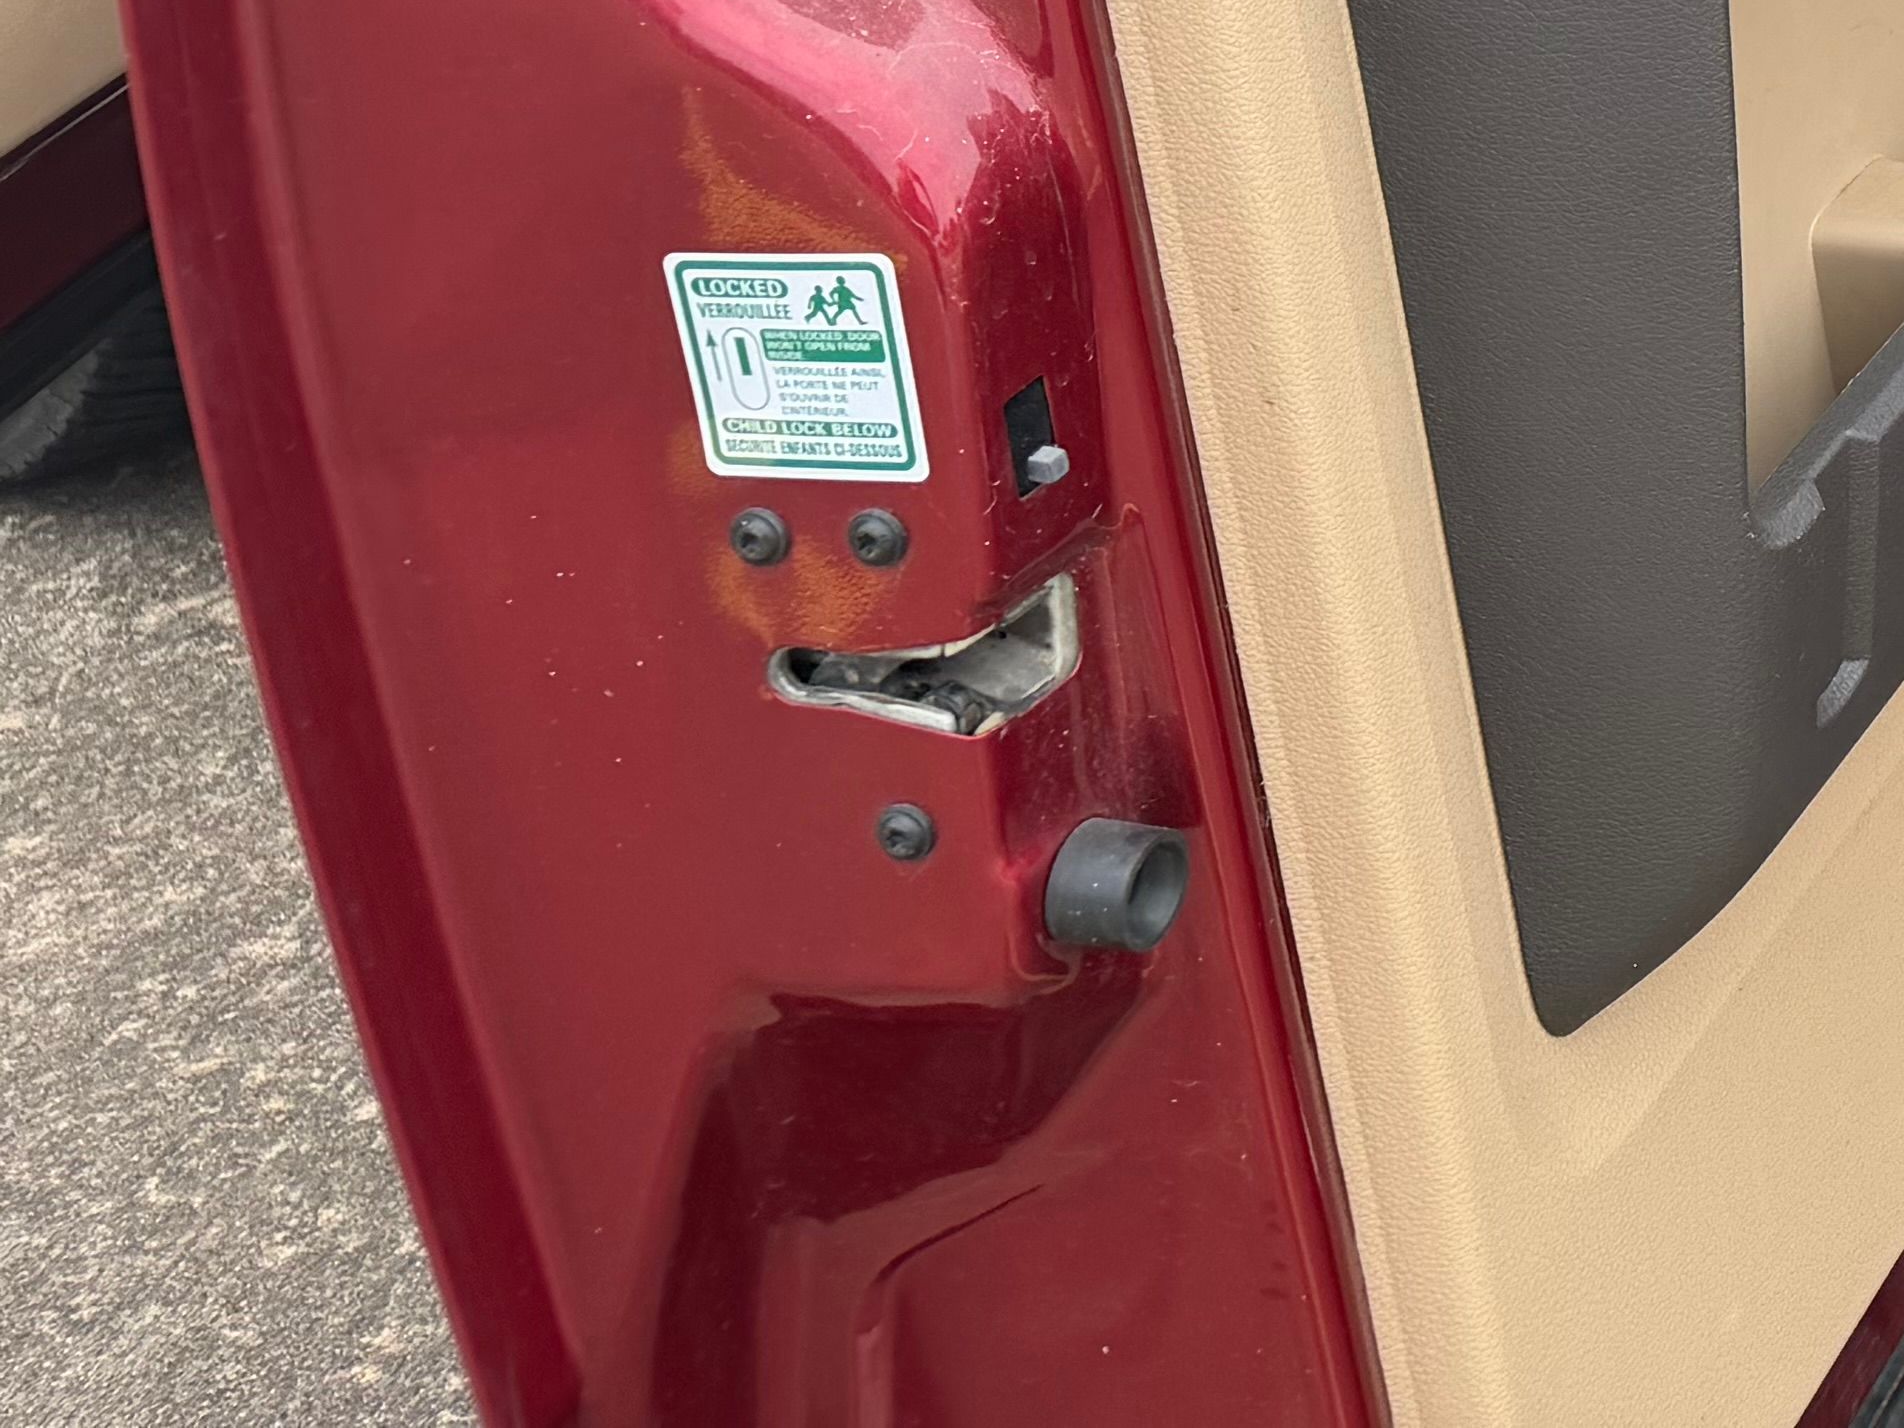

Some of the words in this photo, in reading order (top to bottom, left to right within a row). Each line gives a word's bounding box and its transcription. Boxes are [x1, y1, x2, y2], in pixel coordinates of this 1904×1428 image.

[698, 279, 782, 296] LOCKED
[847, 332, 880, 341] DOOR
[776, 380, 790, 389] LA
[793, 380, 829, 390] PORTE
[831, 381, 847, 390] NE
[850, 381, 880, 391] PEUT
[834, 393, 849, 403] DE
[726, 419, 777, 434] CHILD
[781, 421, 827, 435] LOCK
[831, 423, 893, 437] BELOW
[781, 440, 831, 455] ENFANTS
